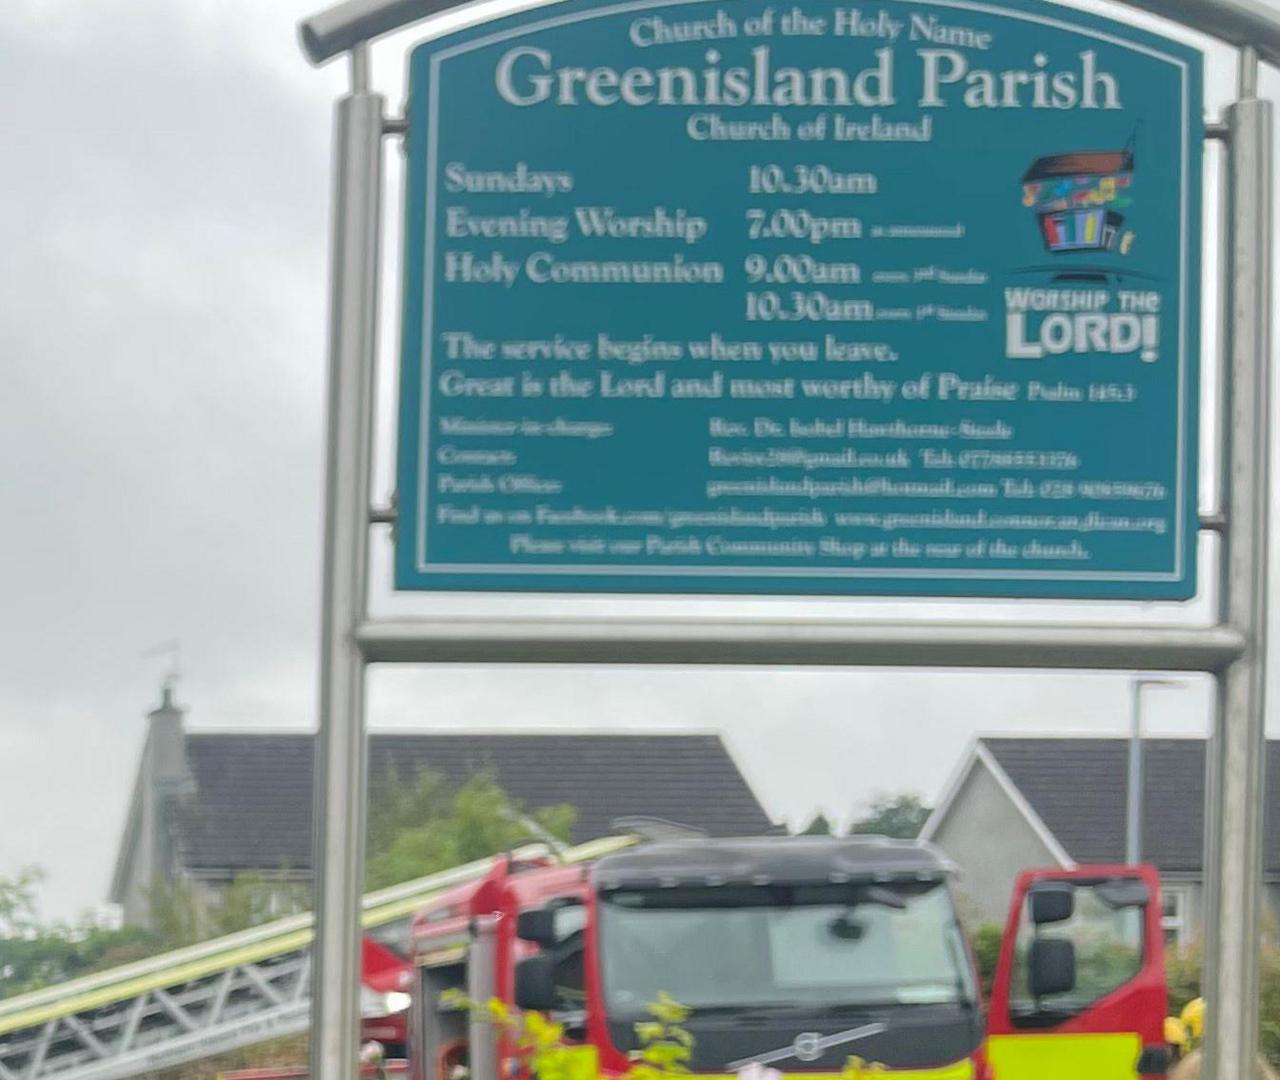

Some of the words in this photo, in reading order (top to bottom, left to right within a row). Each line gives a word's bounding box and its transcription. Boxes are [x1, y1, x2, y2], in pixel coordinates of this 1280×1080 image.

[629, 12, 737, 46] Church
[744, 6, 775, 36] of
[781, 8, 827, 36] the
[834, 10, 901, 40] Holy
[909, 12, 993, 51] Name
[496, 46, 897, 107] Greenisland
[917, 50, 1123, 109] Parish
[686, 112, 791, 141] Church
[797, 112, 828, 141] of
[834, 113, 932, 143] Ireland
[444, 161, 573, 198] Sundays
[748, 164, 878, 194] 10.30am
[446, 206, 569, 243] Evening
[574, 206, 707, 244] Worship
[745, 209, 862, 244] 7.00pm
[444, 252, 522, 288] Holy
[525, 252, 724, 283] Communion
[744, 254, 861, 284] 9.00am
[746, 291, 874, 321] 10.30am
[1005, 287, 1109, 312] WORSHIP
[443, 332, 496, 360] The
[501, 334, 590, 360] service
[598, 333, 683, 366] begins
[689, 333, 763, 361] when
[768, 336, 818, 366] you
[825, 334, 899, 362] leave.
[1005, 313, 1159, 363] LORD!
[440, 370, 515, 397] Great
[521, 370, 544, 397] is
[549, 370, 592, 397] the
[600, 370, 666, 398] Lord
[671, 370, 724, 398] and
[729, 372, 796, 399] most
[801, 374, 895, 404] worthy
[901, 374, 931, 400] of
[939, 375, 1017, 402] Praise
